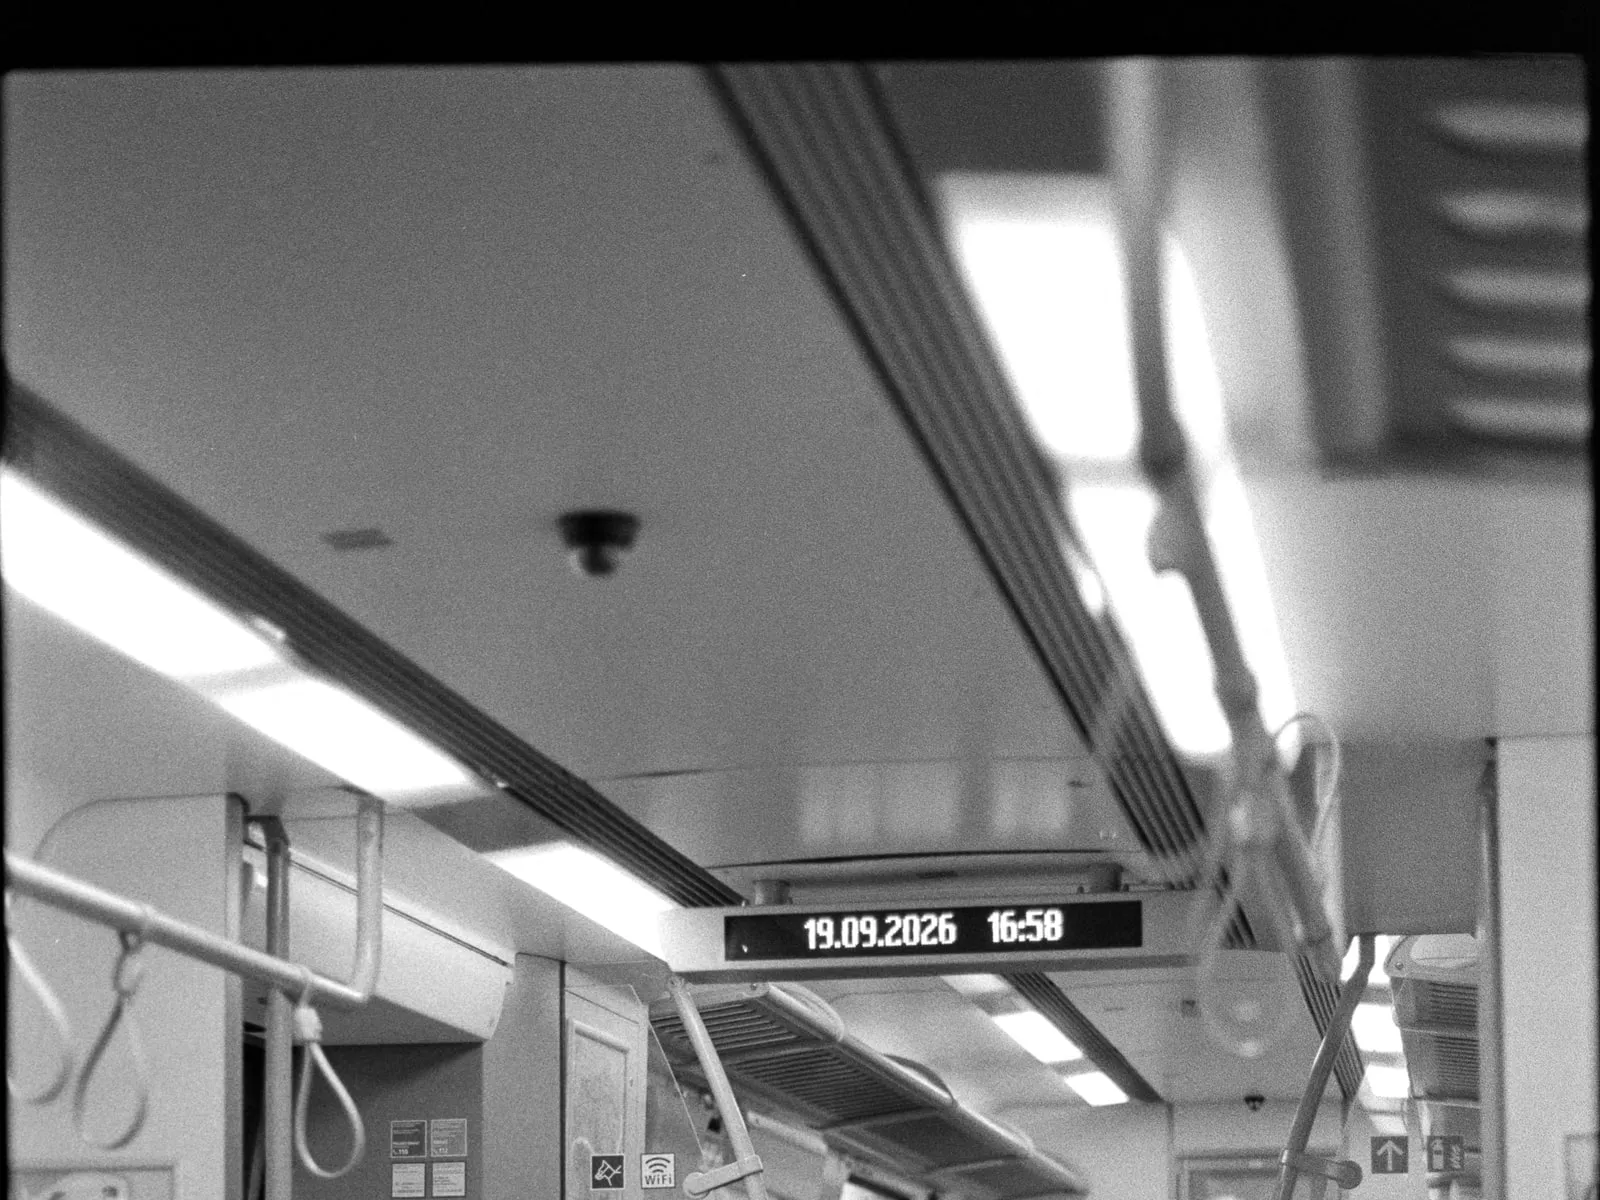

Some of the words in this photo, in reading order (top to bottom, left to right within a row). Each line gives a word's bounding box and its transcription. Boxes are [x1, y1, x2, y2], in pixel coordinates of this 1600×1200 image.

[803, 913, 958, 950] 19.09.2026
[987, 908, 1064, 944] 16:58
[644, 1174, 672, 1185] WiFi
